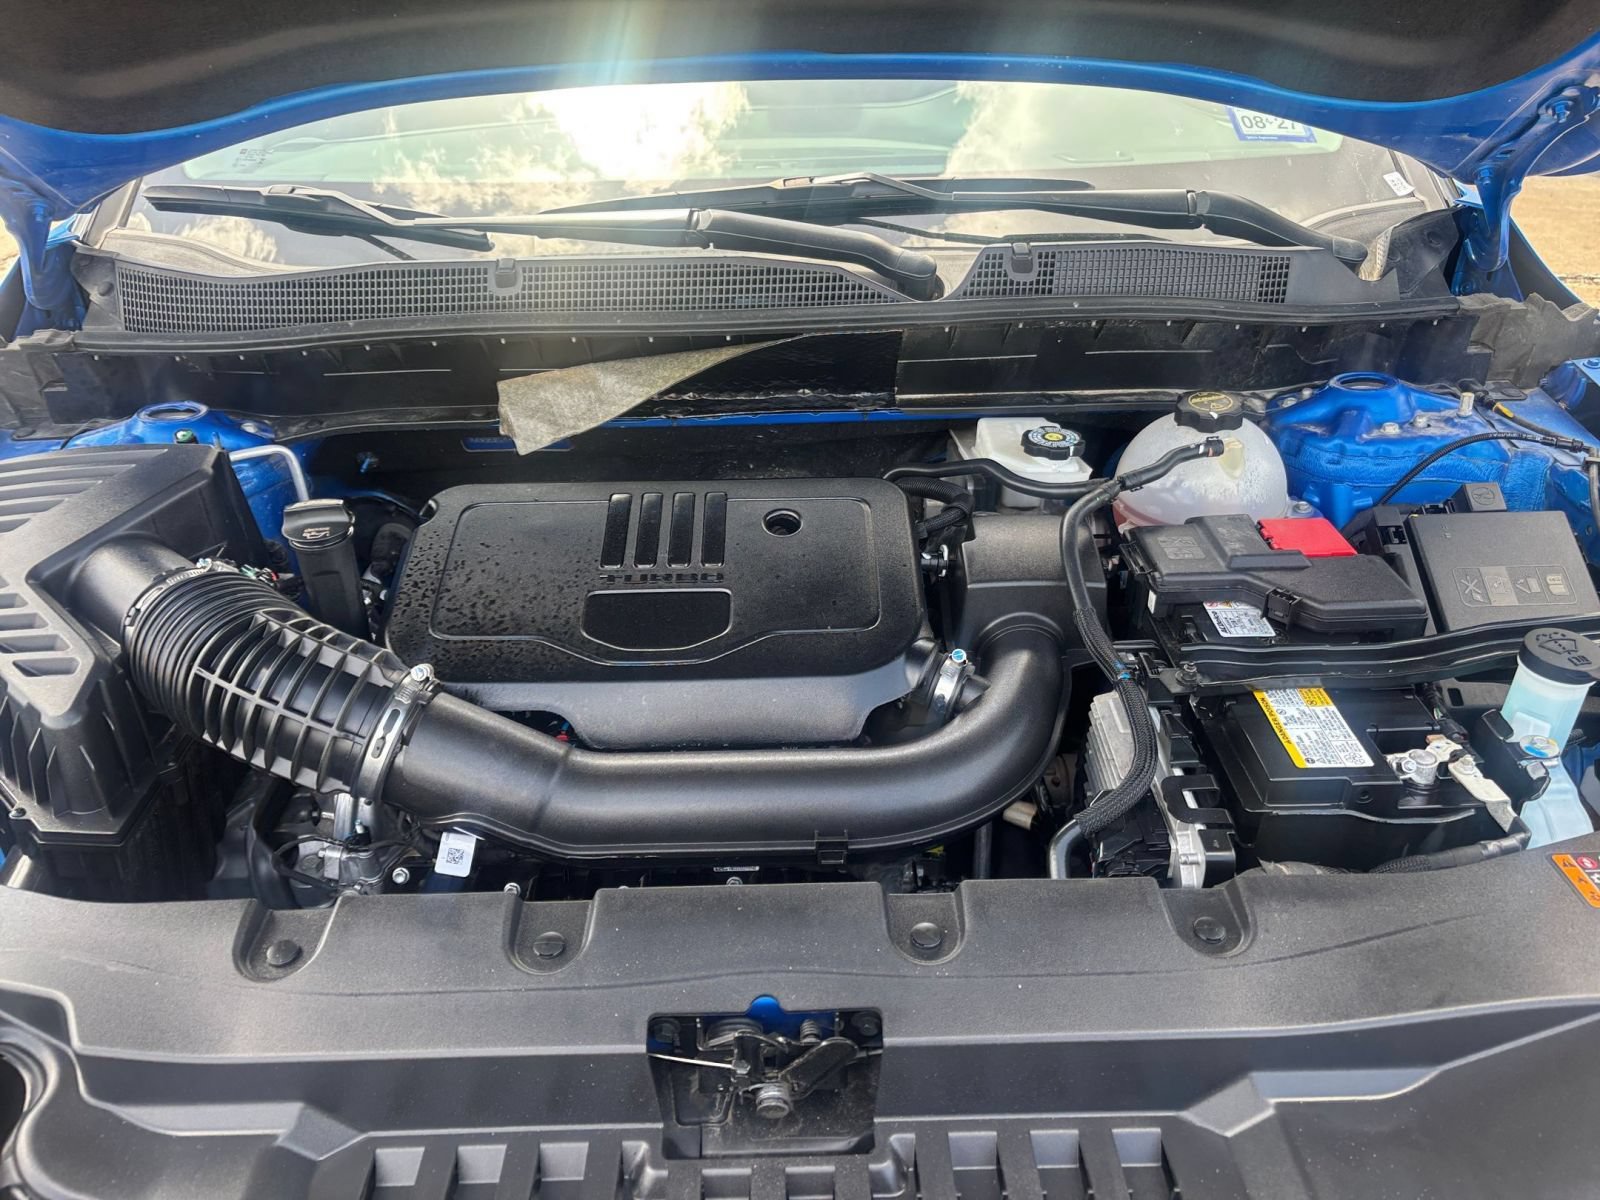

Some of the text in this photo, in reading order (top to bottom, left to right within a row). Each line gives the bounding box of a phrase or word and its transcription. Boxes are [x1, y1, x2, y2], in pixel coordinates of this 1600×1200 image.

[1240, 115, 1267, 129] 08
[599, 573, 724, 585] TURBO
[1259, 697, 1288, 739] DANGER POISON
